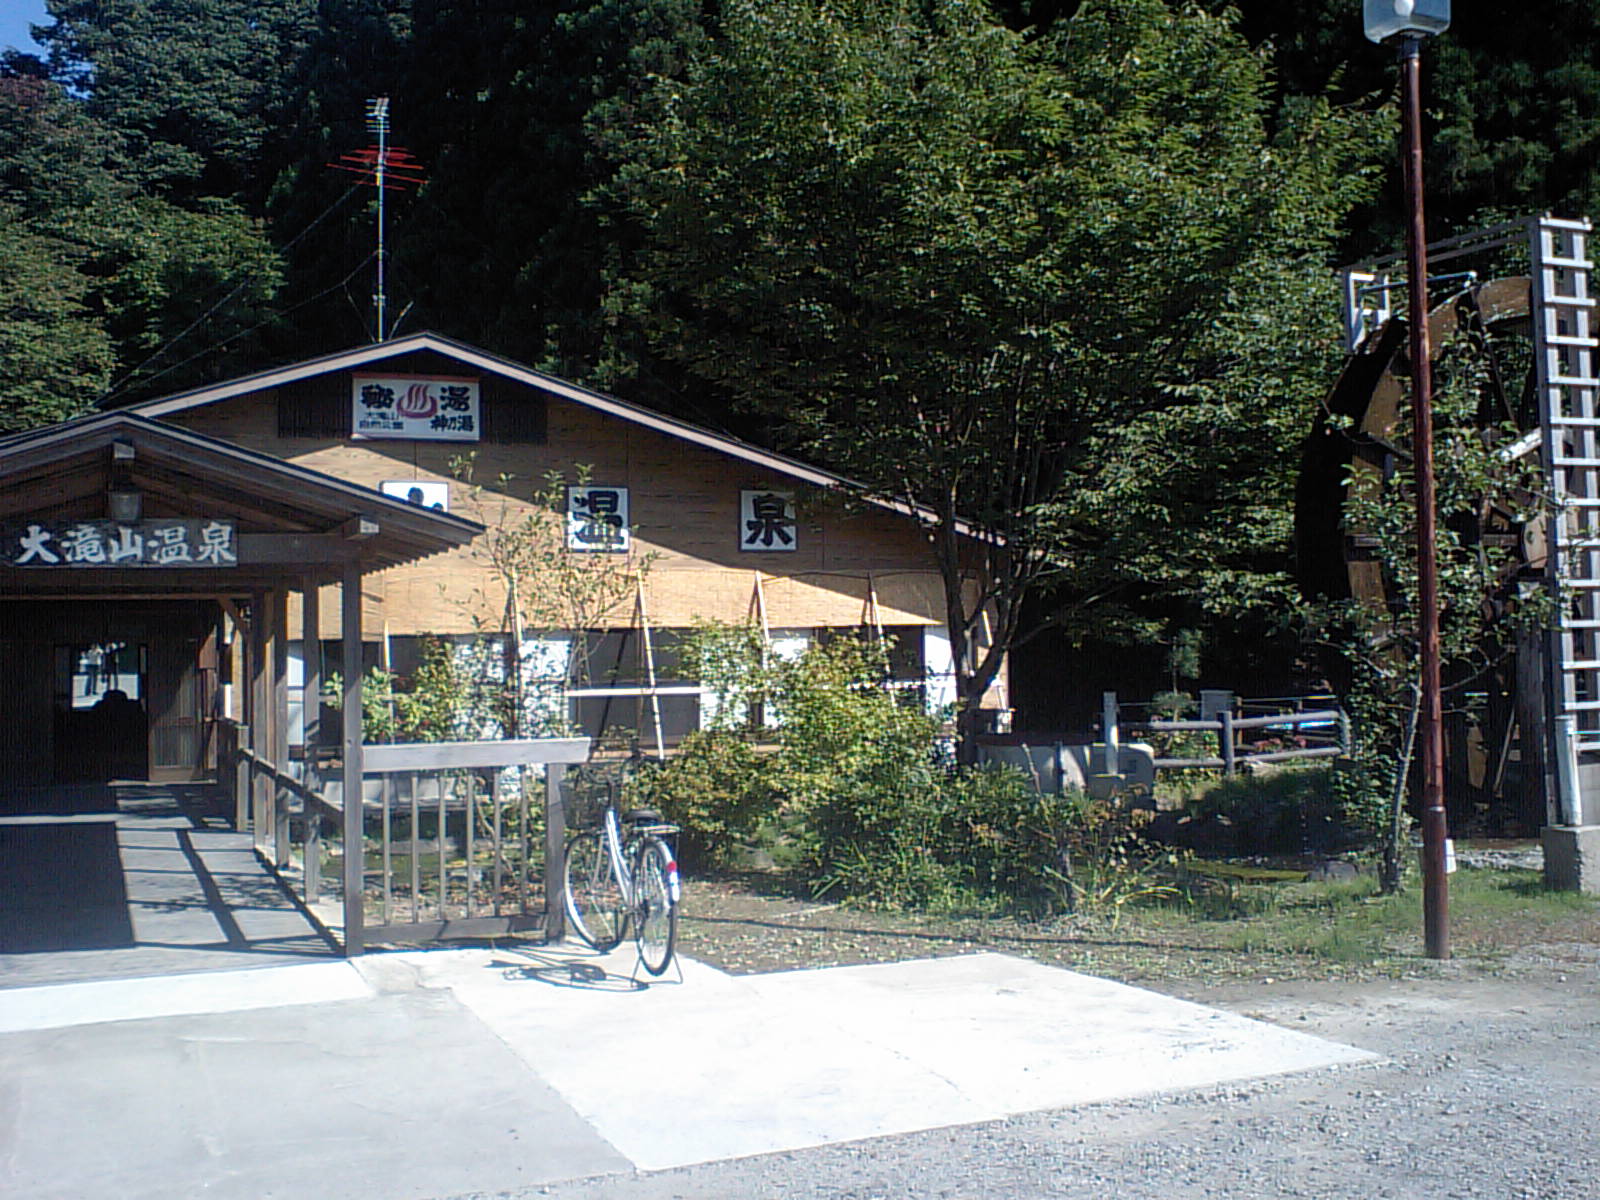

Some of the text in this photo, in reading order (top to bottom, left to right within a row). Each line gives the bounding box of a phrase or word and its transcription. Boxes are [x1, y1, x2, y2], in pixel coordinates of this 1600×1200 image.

[14, 521, 238, 564] 大滝山温泉
[572, 490, 794, 546] 温 泉
